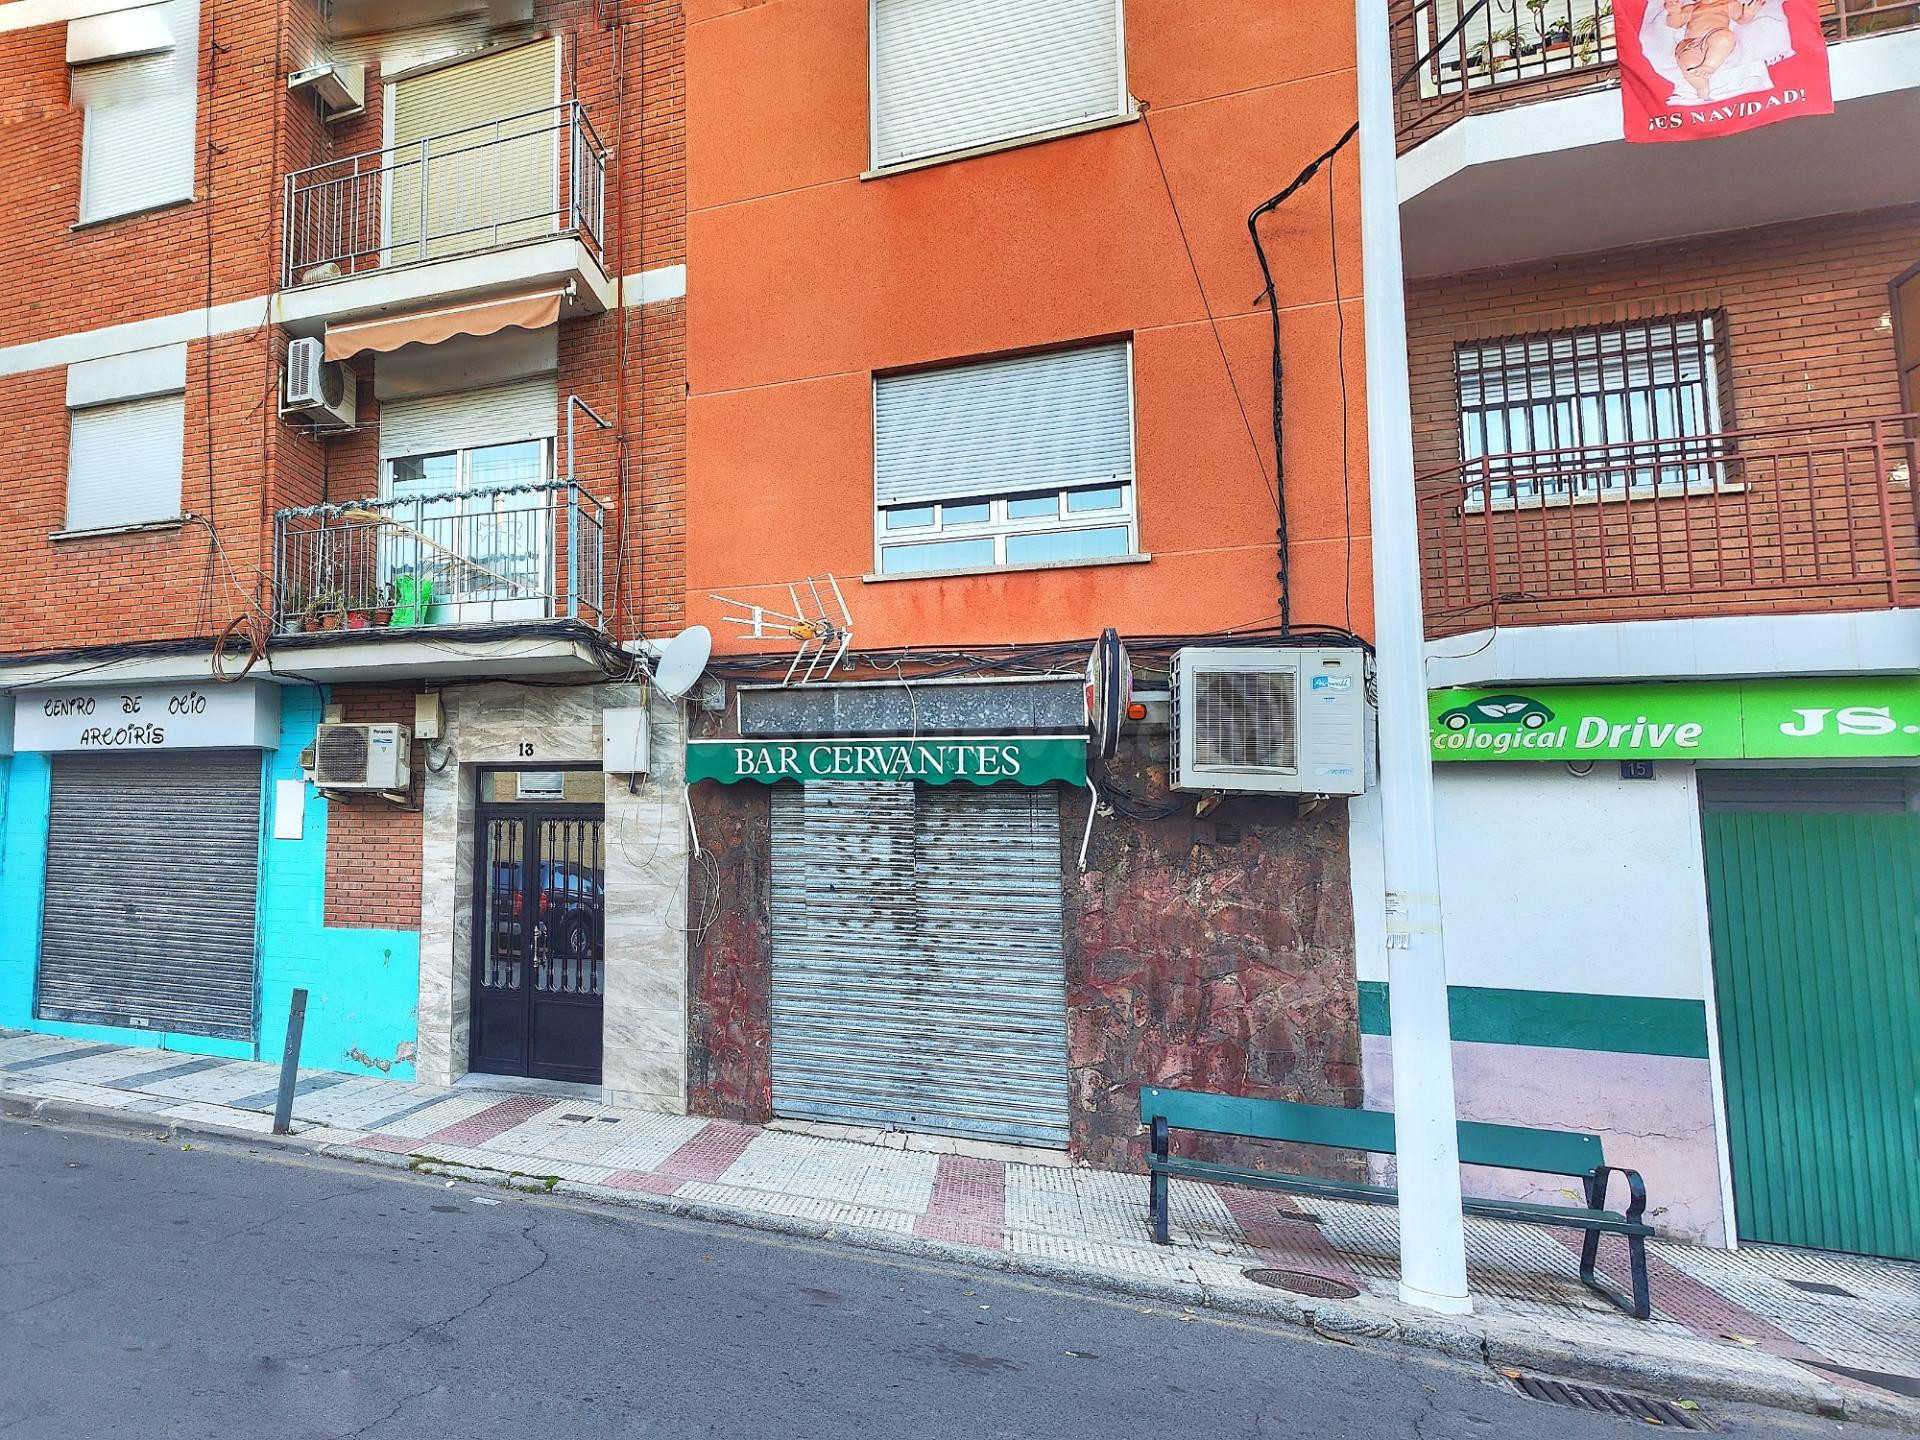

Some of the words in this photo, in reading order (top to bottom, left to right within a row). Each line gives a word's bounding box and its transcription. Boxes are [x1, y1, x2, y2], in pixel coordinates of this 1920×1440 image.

[1648, 113, 1683, 131] ¡ES
[1690, 89, 1806, 125] NAVIDAD!
[44, 697, 96, 717] CENTRO
[121, 695, 142, 714] DE
[1429, 726, 1568, 754] cological
[1575, 716, 1704, 749] Drive
[519, 743, 534, 756] 13
[735, 747, 802, 775] BAR
[809, 745, 1020, 775] CERVANTES
[1628, 762, 1646, 776] 15
